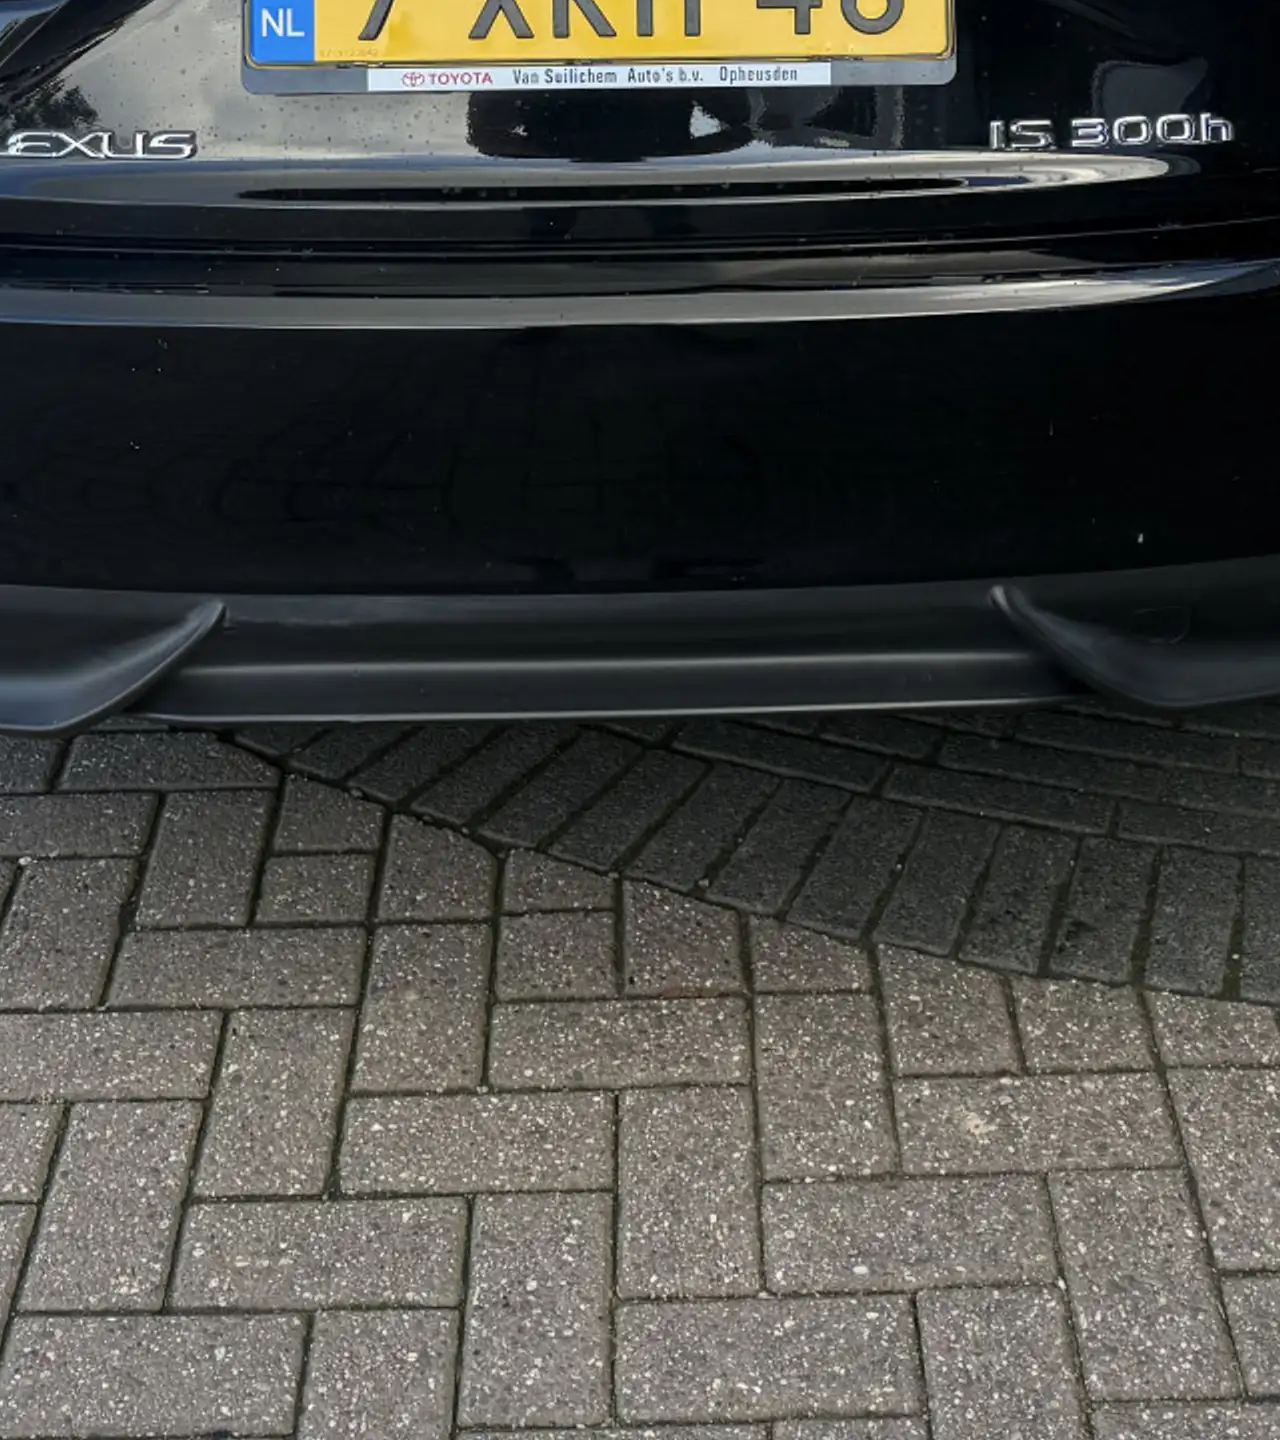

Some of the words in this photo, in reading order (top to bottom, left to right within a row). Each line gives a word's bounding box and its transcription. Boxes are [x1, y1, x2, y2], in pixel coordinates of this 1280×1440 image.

[260, 9, 306, 39] NL
[431, 74, 493, 85] TOYOTA
[513, 69, 540, 83] Van
[544, 67, 618, 84] Suilichem
[628, 66, 673, 83] Auto's
[678, 68, 704, 82] b.v.
[719, 65, 798, 85] Opheusden
[989, 120, 1058, 150] IS
[1070, 113, 1235, 148] 300h
